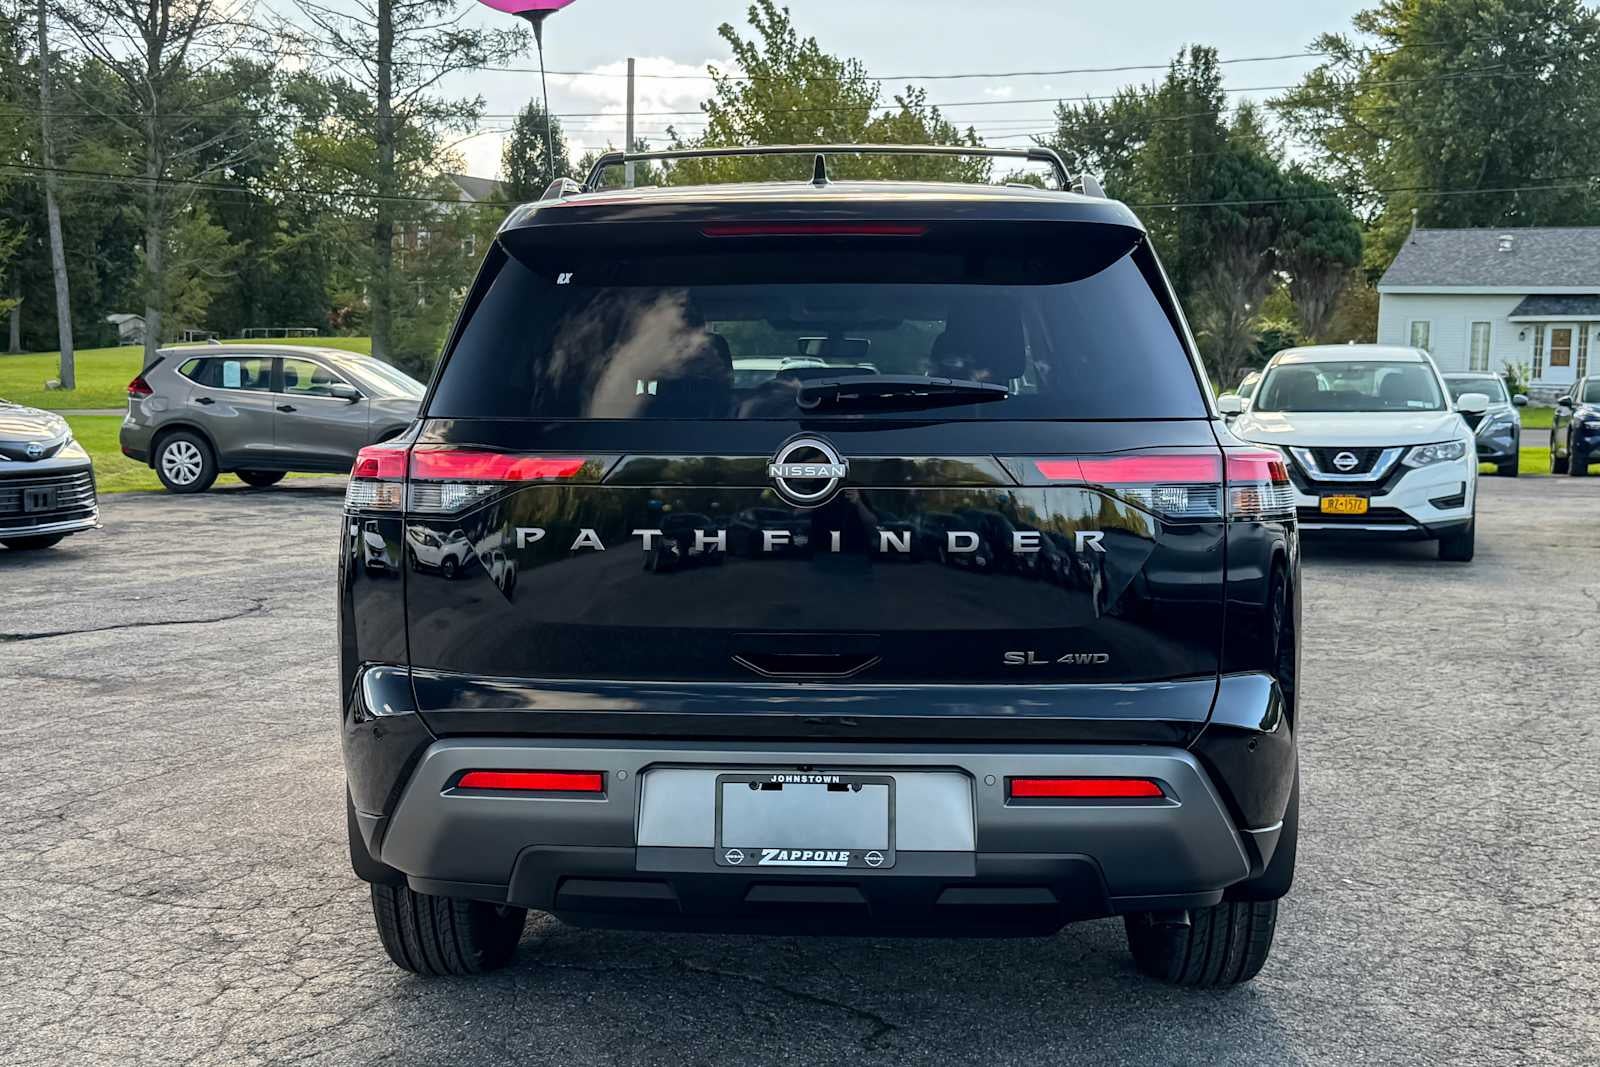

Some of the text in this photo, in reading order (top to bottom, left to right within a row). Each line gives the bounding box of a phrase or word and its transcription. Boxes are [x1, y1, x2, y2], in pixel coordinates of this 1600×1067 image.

[771, 466, 843, 476] NISSAN
[515, 527, 1107, 553] PATHFINDER
[1003, 651, 1110, 665] SL 4WD
[770, 775, 840, 784] JOHNSTOWN
[758, 848, 850, 866] ZAPPONE
